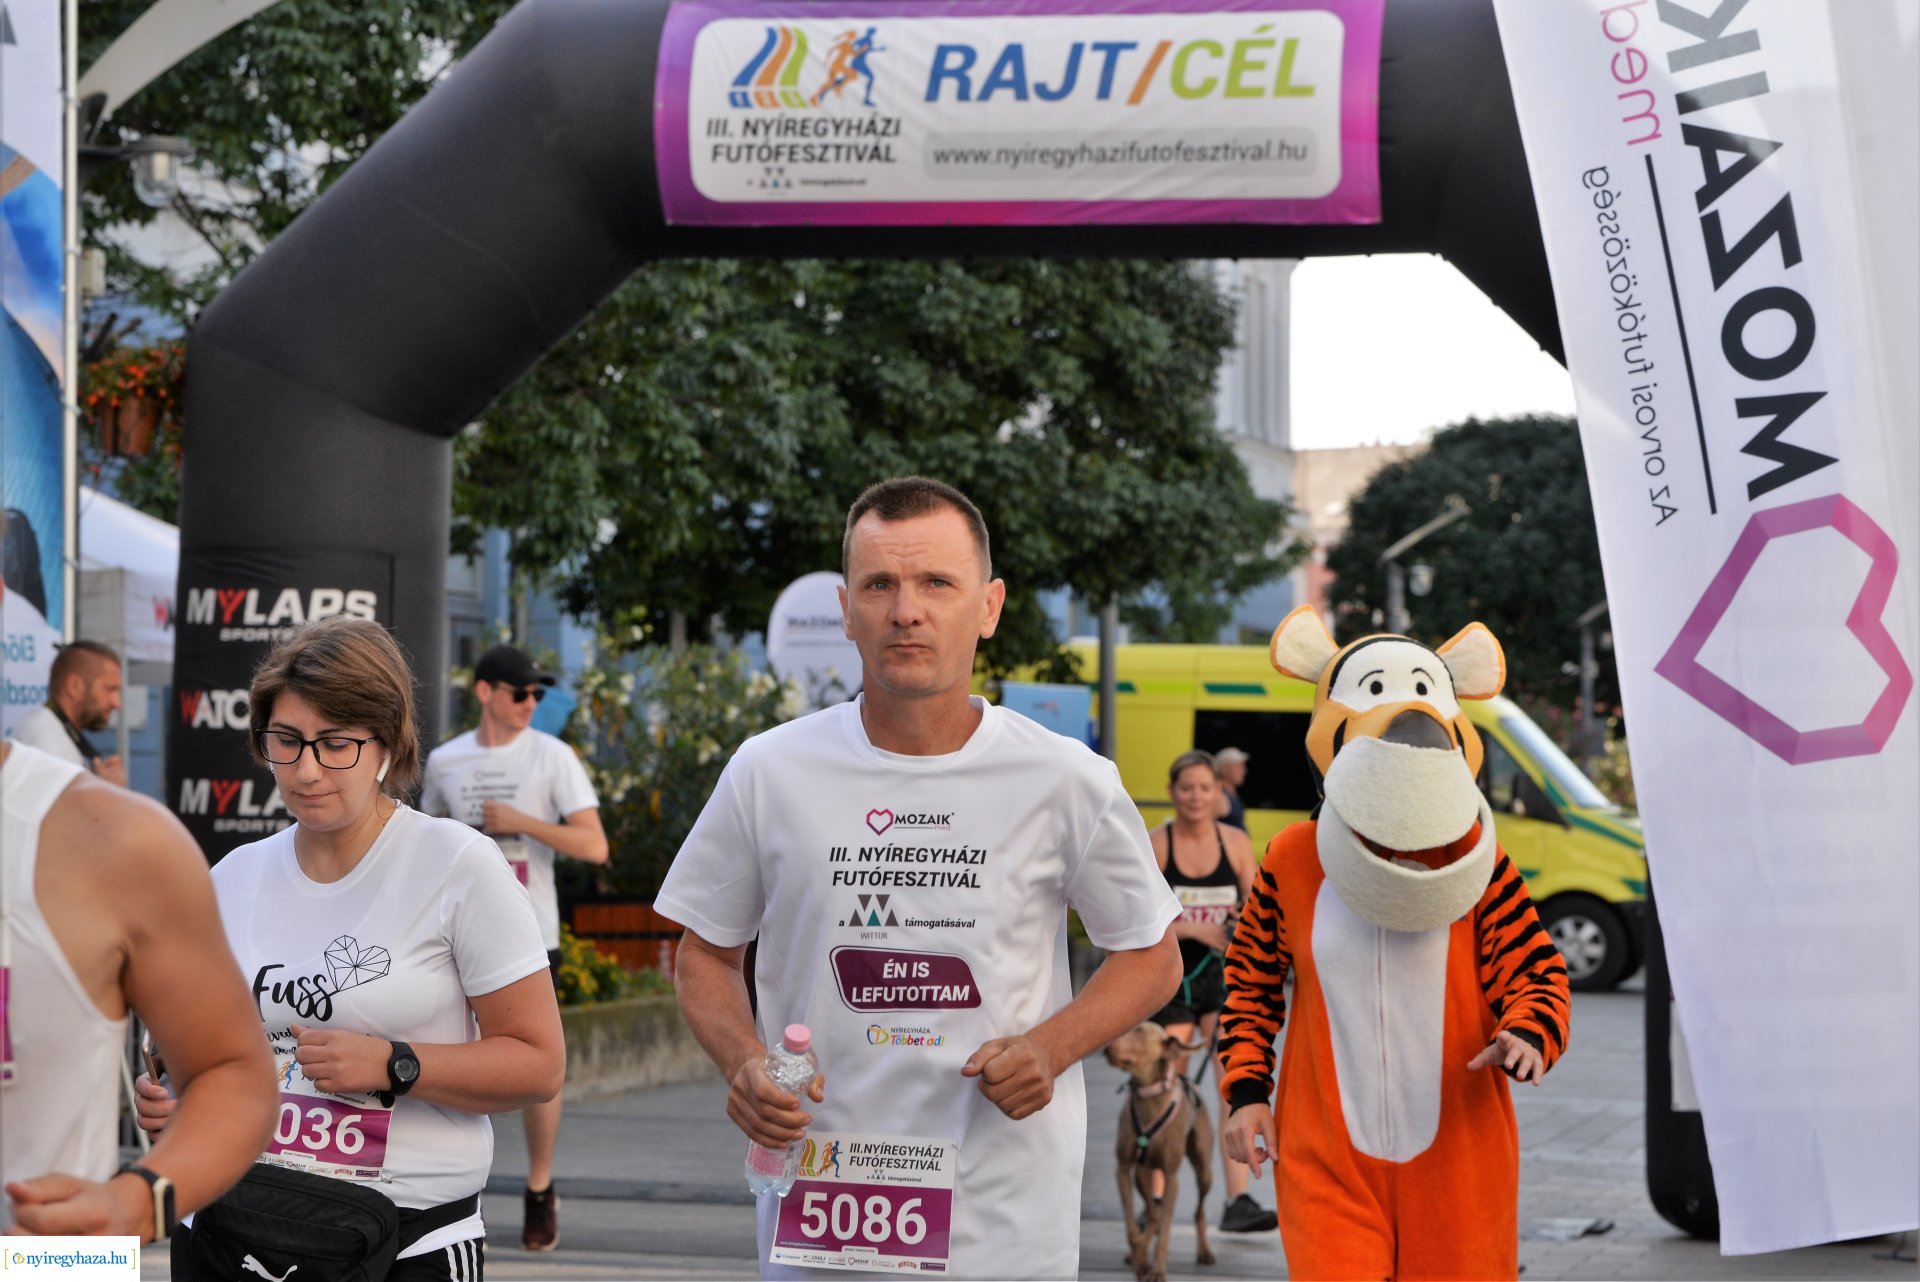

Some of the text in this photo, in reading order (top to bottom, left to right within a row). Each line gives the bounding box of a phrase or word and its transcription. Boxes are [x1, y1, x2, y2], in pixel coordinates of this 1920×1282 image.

[924, 24, 1316, 106] RAJT/CÉL
[706, 112, 901, 137] III. NYÍREGYHÁZI
[711, 137, 896, 163] FUTÓFESZTIVÁL
[933, 140, 1308, 169] www.nyiregyhazifutofesztival.hu
[186, 588, 377, 625] MYLAPS
[179, 689, 250, 729] WATC
[179, 778, 293, 816] MYLA
[894, 813, 951, 825] MOZAIK
[829, 843, 987, 865] III. NYÍREGYHÁZI
[832, 867, 981, 888] FUTÓFESZTIVÁL
[838, 918, 976, 930] a támogatásával
[860, 932, 888, 940] WITTUR
[882, 958, 930, 979] ÉN IS
[252, 964, 333, 1022] Fuss
[851, 985, 970, 1003] LEFUTOTTAM
[890, 1026, 931, 1035] NYÍREGYHÁZA
[890, 1034, 945, 1046] Többet ad!
[274, 1102, 365, 1155] 036
[849, 1155, 941, 1171] FUTÓFESZTIVÁL
[800, 1191, 927, 1245] 5086
